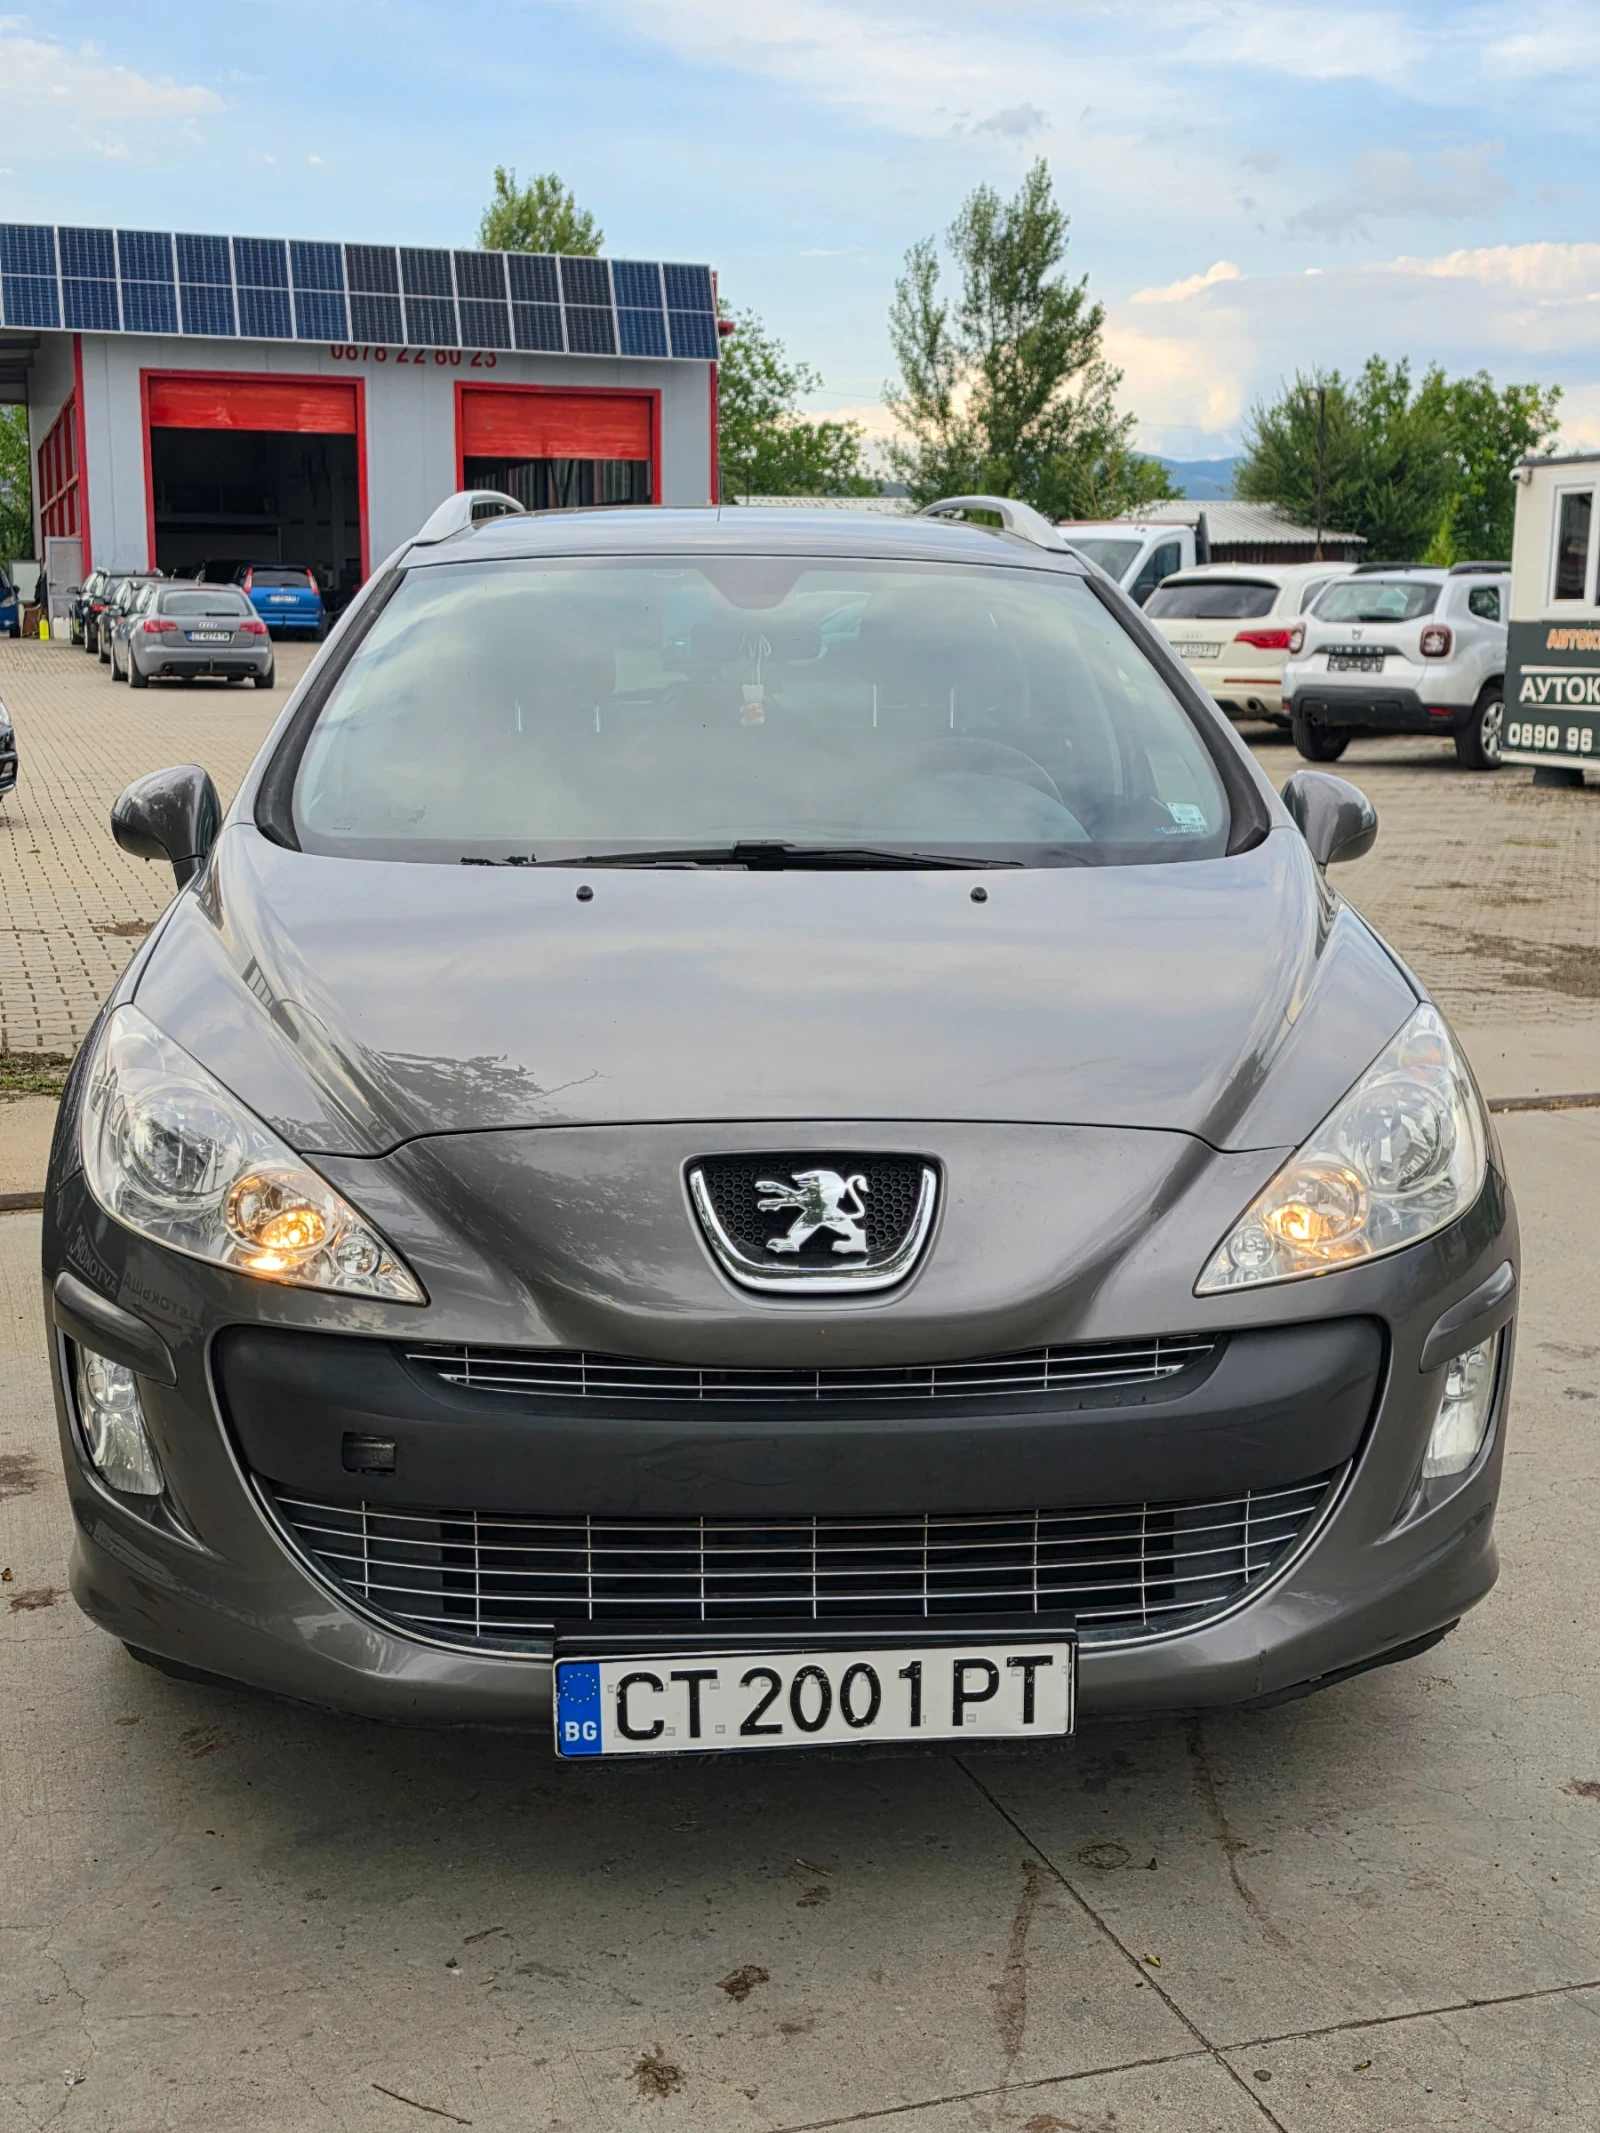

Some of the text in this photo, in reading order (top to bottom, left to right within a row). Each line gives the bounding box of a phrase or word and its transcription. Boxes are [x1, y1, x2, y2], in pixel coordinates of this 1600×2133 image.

[396, 347, 426, 364] 22
[1546, 628, 1600, 650] АВТОК
[1508, 722, 1593, 752] 0890 96
[617, 1655, 1053, 1741] CT 2001 PT
[565, 1721, 597, 1742] BG
